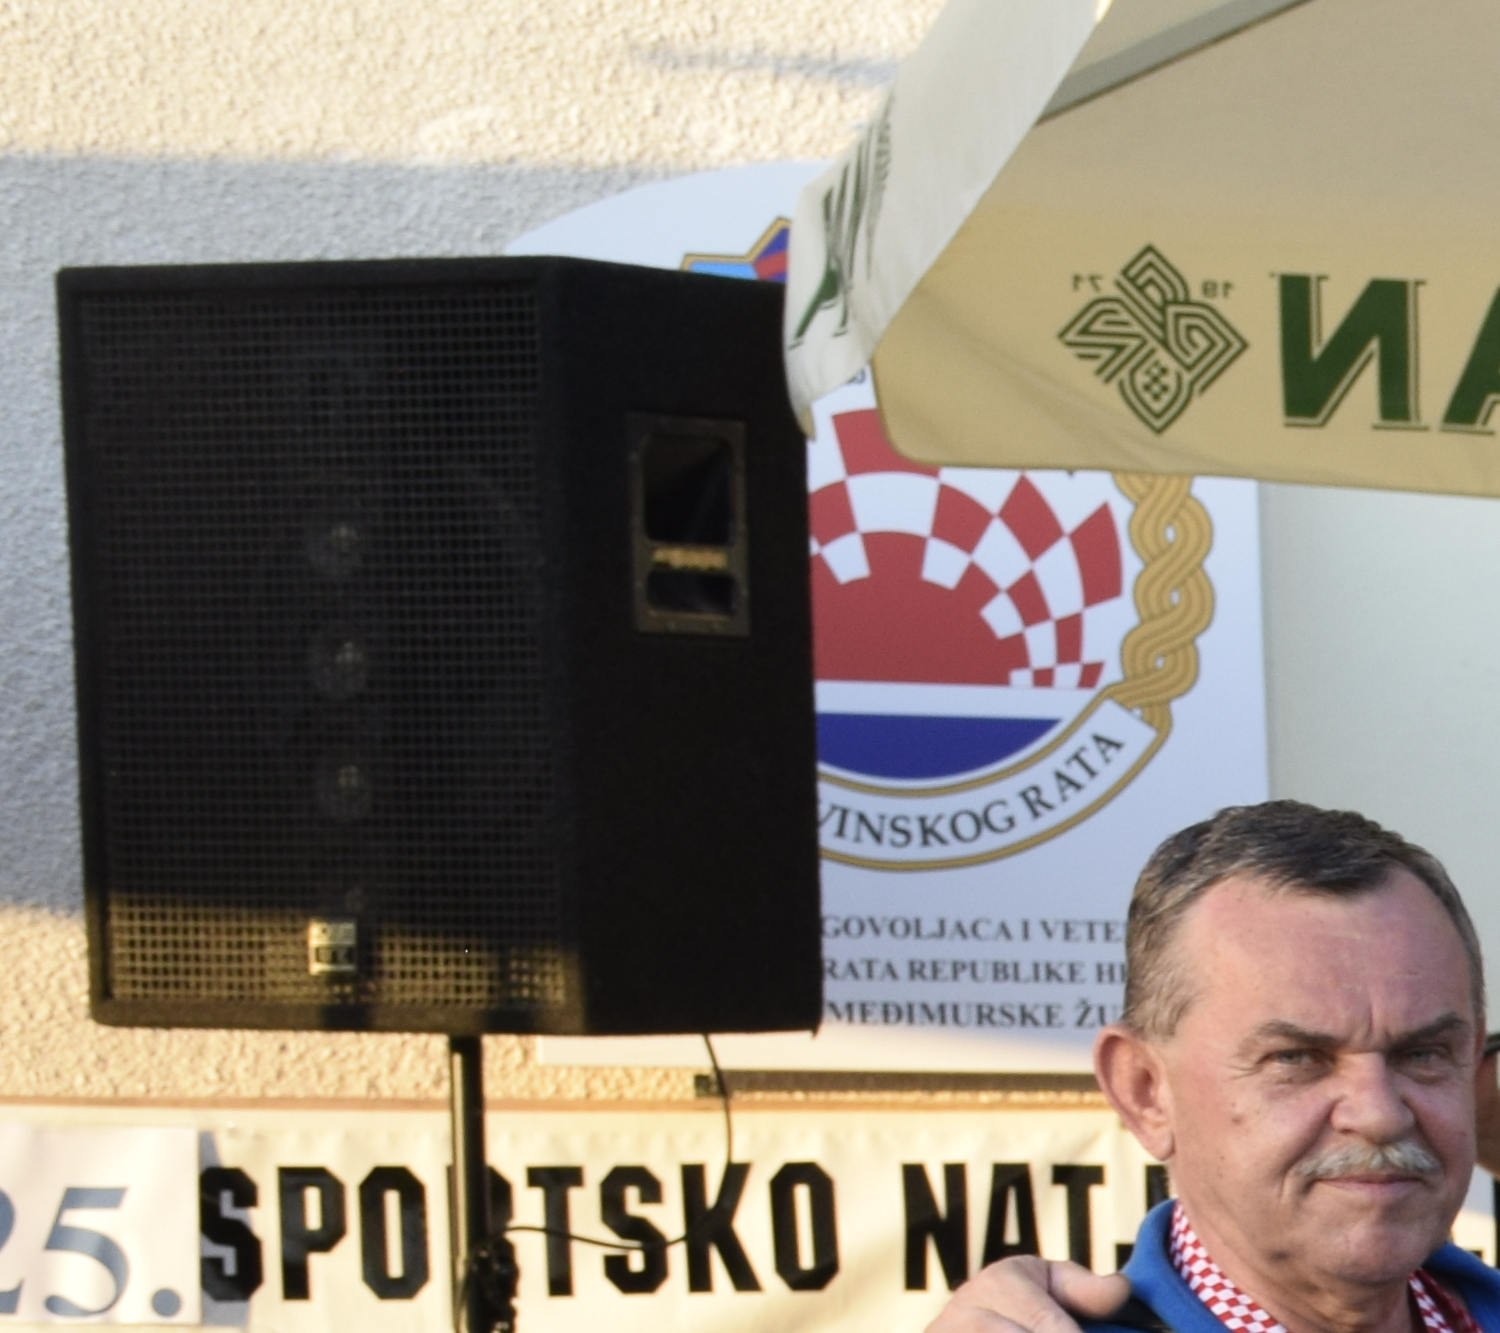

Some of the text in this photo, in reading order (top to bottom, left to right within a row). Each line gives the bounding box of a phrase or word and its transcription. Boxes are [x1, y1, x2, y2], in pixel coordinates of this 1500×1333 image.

[1018, 731, 1125, 821] RATA
[1021, 918, 1031, 942] I
[1040, 919, 1128, 943] VETE
[908, 960, 1086, 985] REPUBLIKE
